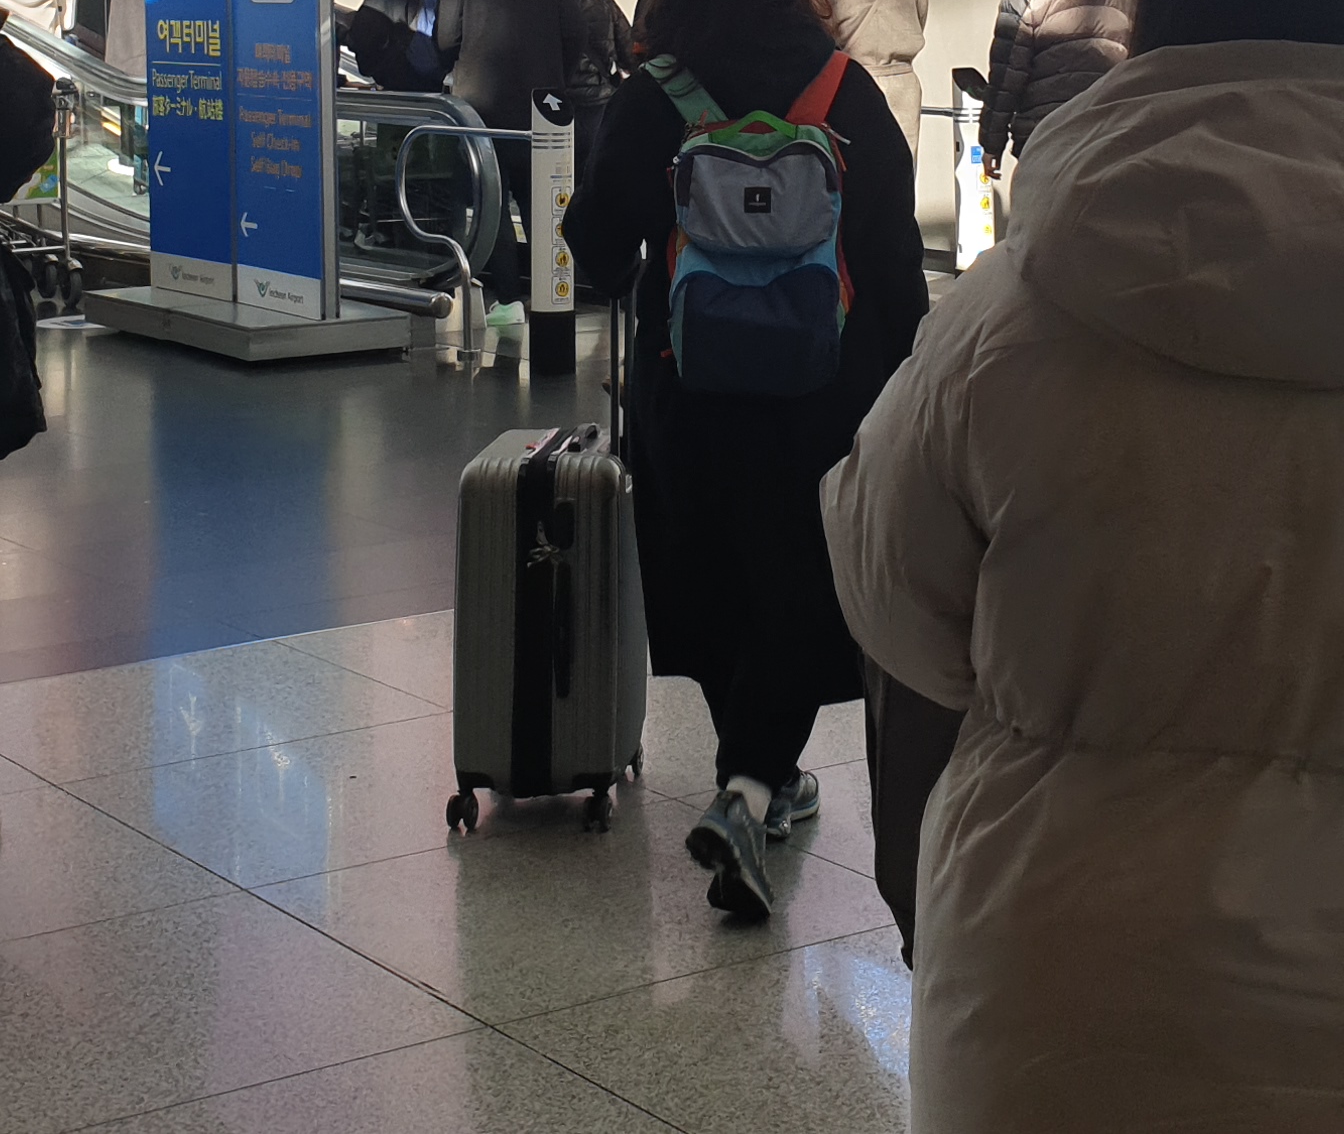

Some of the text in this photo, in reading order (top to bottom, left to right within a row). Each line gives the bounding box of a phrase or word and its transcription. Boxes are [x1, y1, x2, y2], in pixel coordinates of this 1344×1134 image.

[157, 19, 221, 57] 여객터미널
[152, 68, 222, 94] Passenger Terminal
